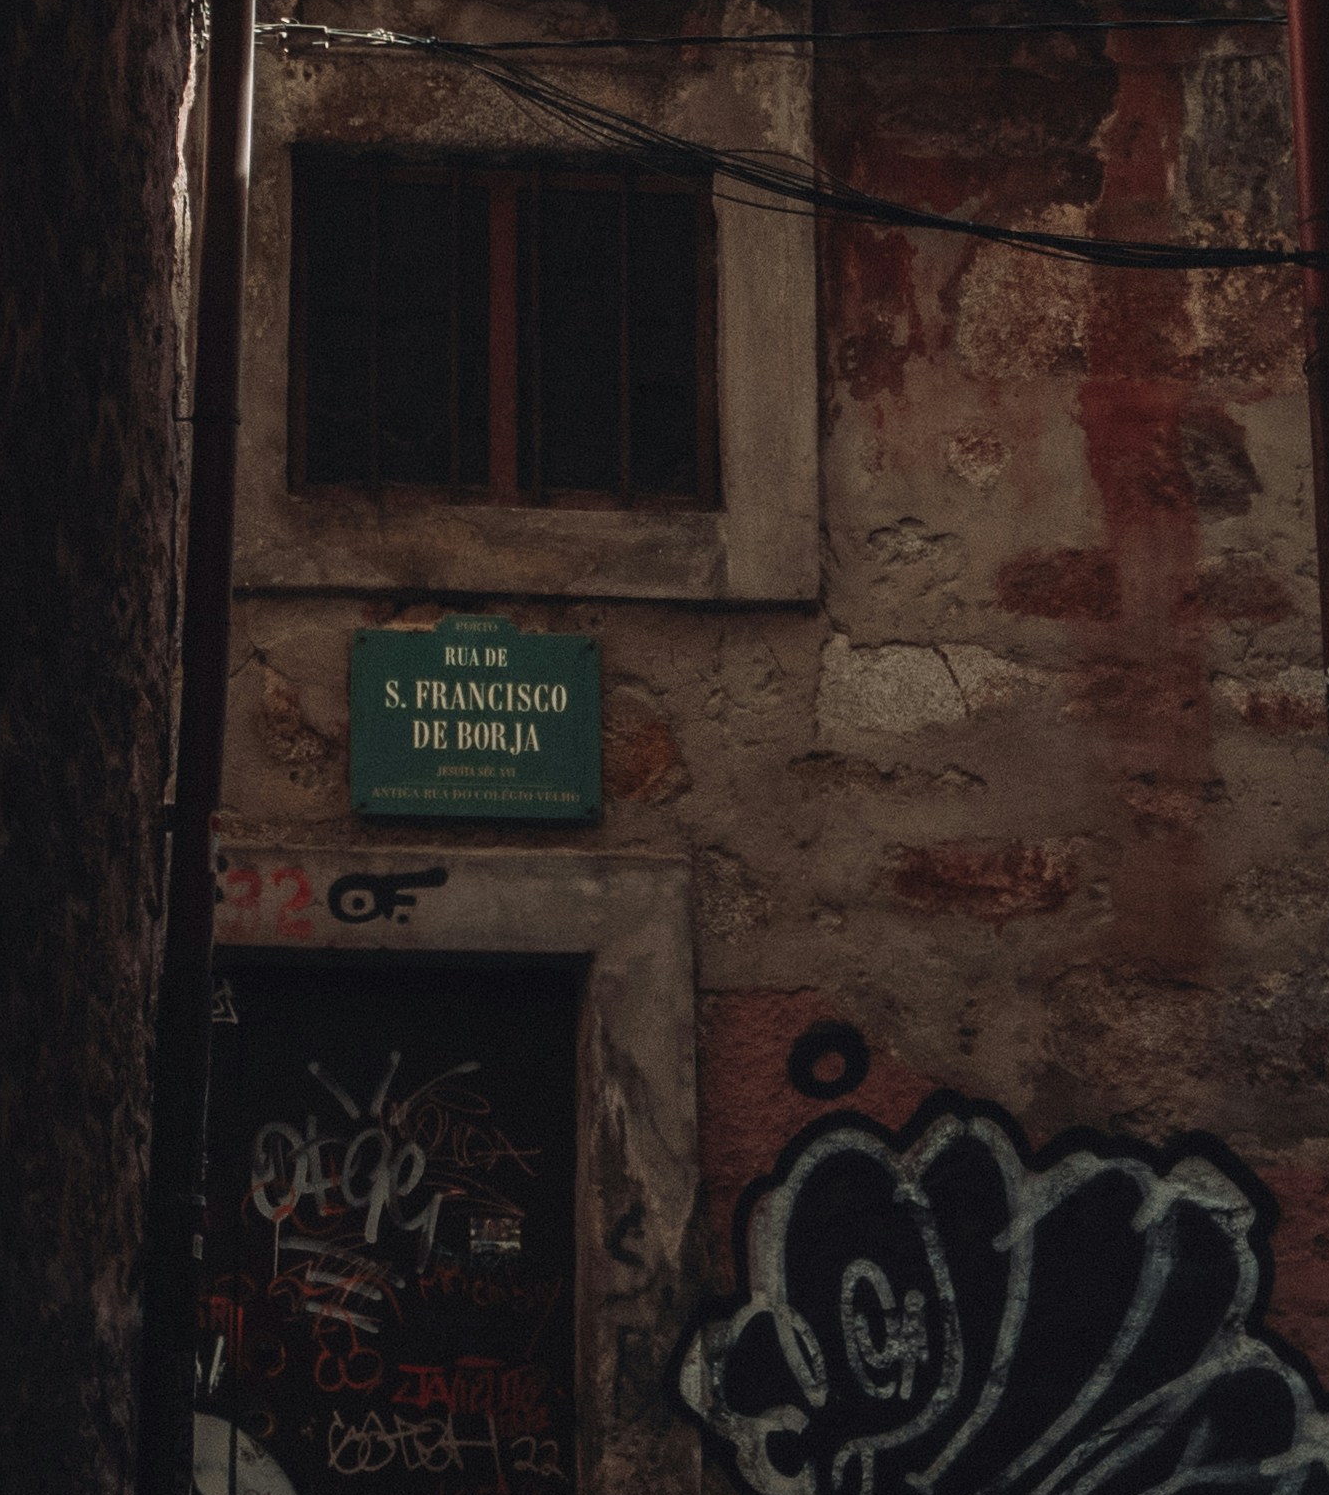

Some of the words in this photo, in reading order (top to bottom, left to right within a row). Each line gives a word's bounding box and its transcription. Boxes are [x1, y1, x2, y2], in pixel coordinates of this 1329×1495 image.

[444, 646, 480, 666] RUA
[484, 647, 508, 667] DE
[384, 679, 407, 709] S.
[414, 680, 567, 713] FRANCISCO
[412, 720, 448, 750] DE
[456, 721, 541, 755] BORJA
